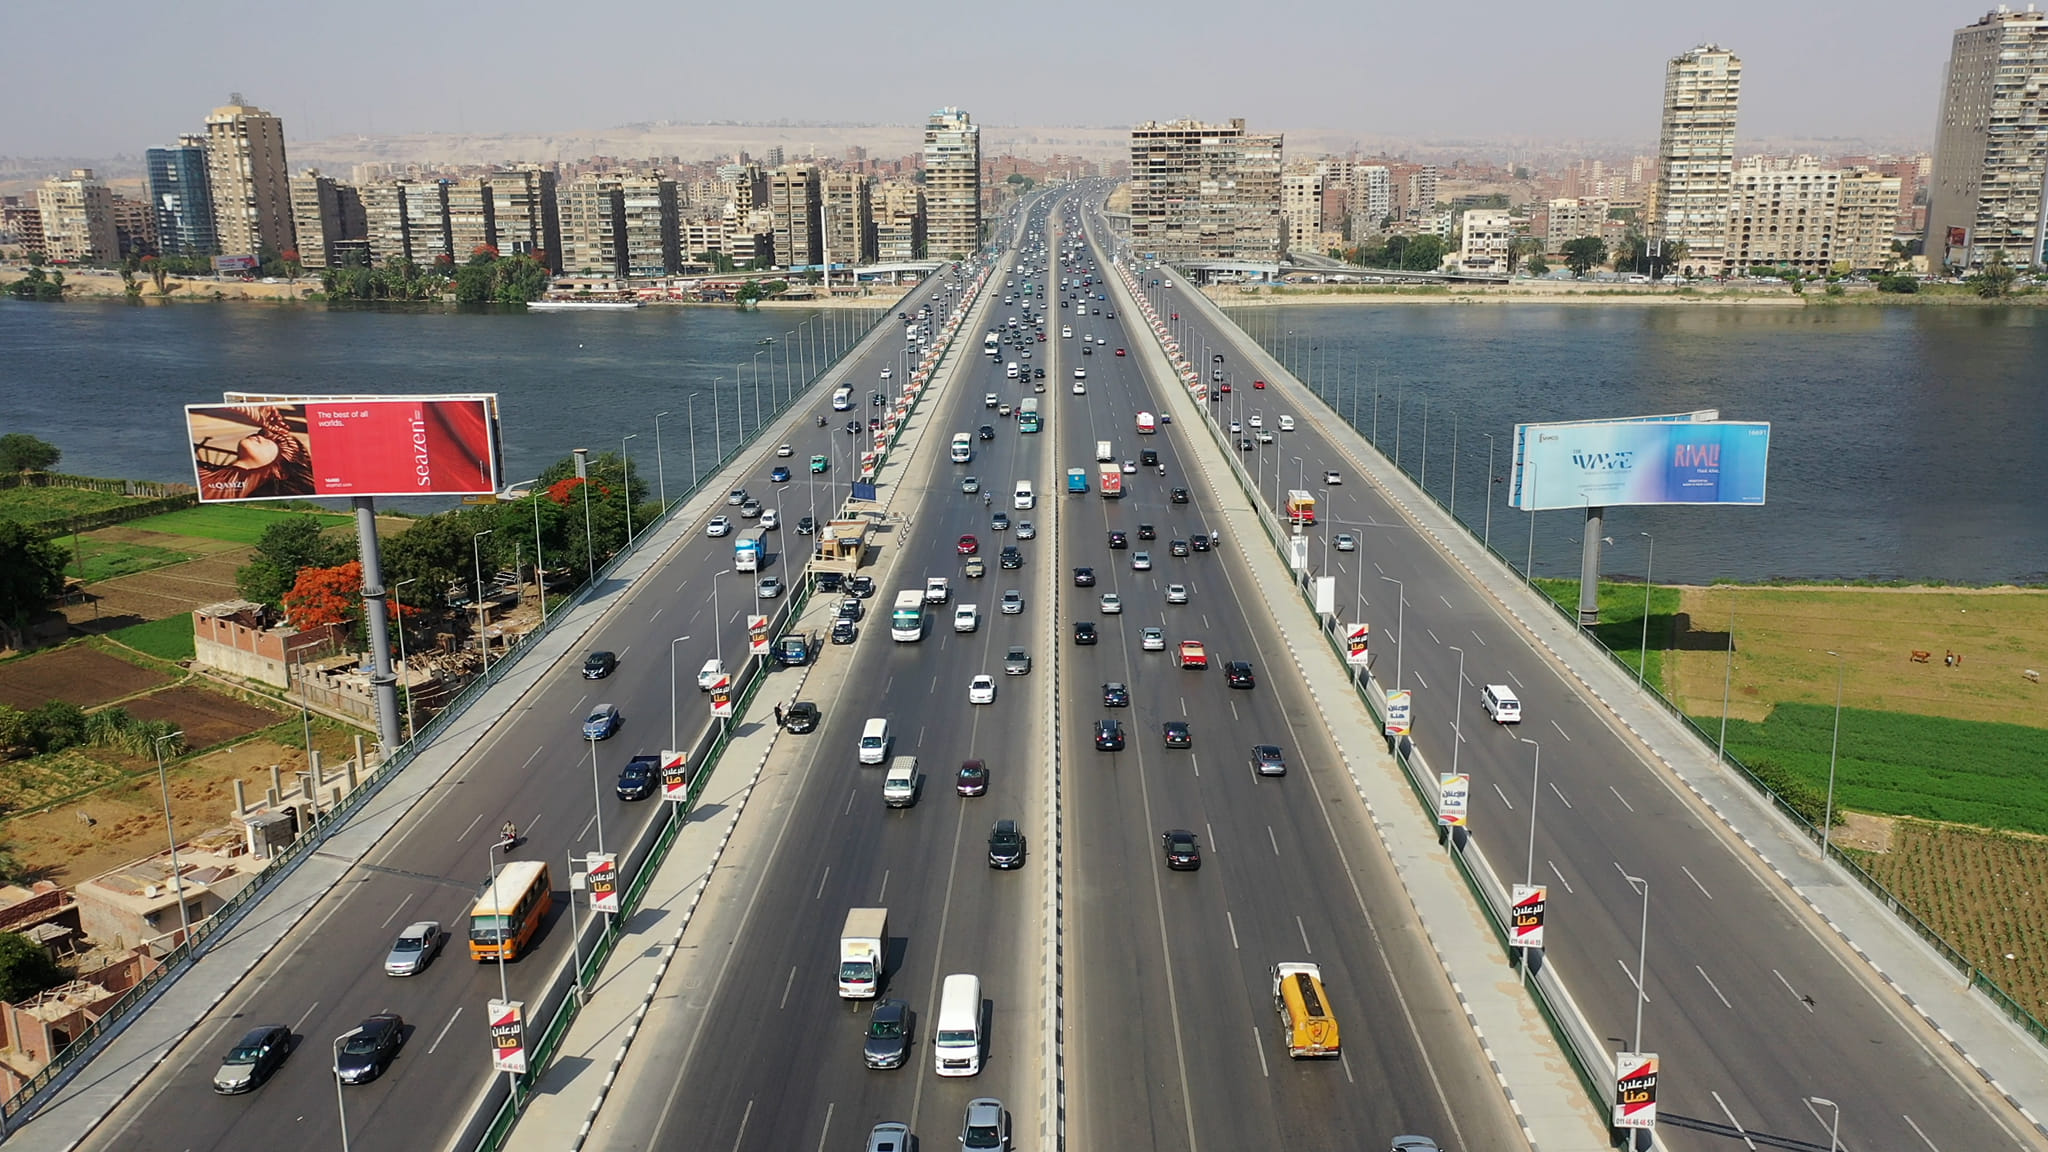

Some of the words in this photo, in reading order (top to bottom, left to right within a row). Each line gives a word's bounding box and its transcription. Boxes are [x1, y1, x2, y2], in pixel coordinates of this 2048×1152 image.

[317, 411, 332, 419] The
[360, 410, 369, 418] all
[1572, 451, 1633, 469] WAVE
[1517, 915, 1538, 926] هنا
[497, 1036, 517, 1048] هنا
[1623, 1090, 1649, 1104] هنا
